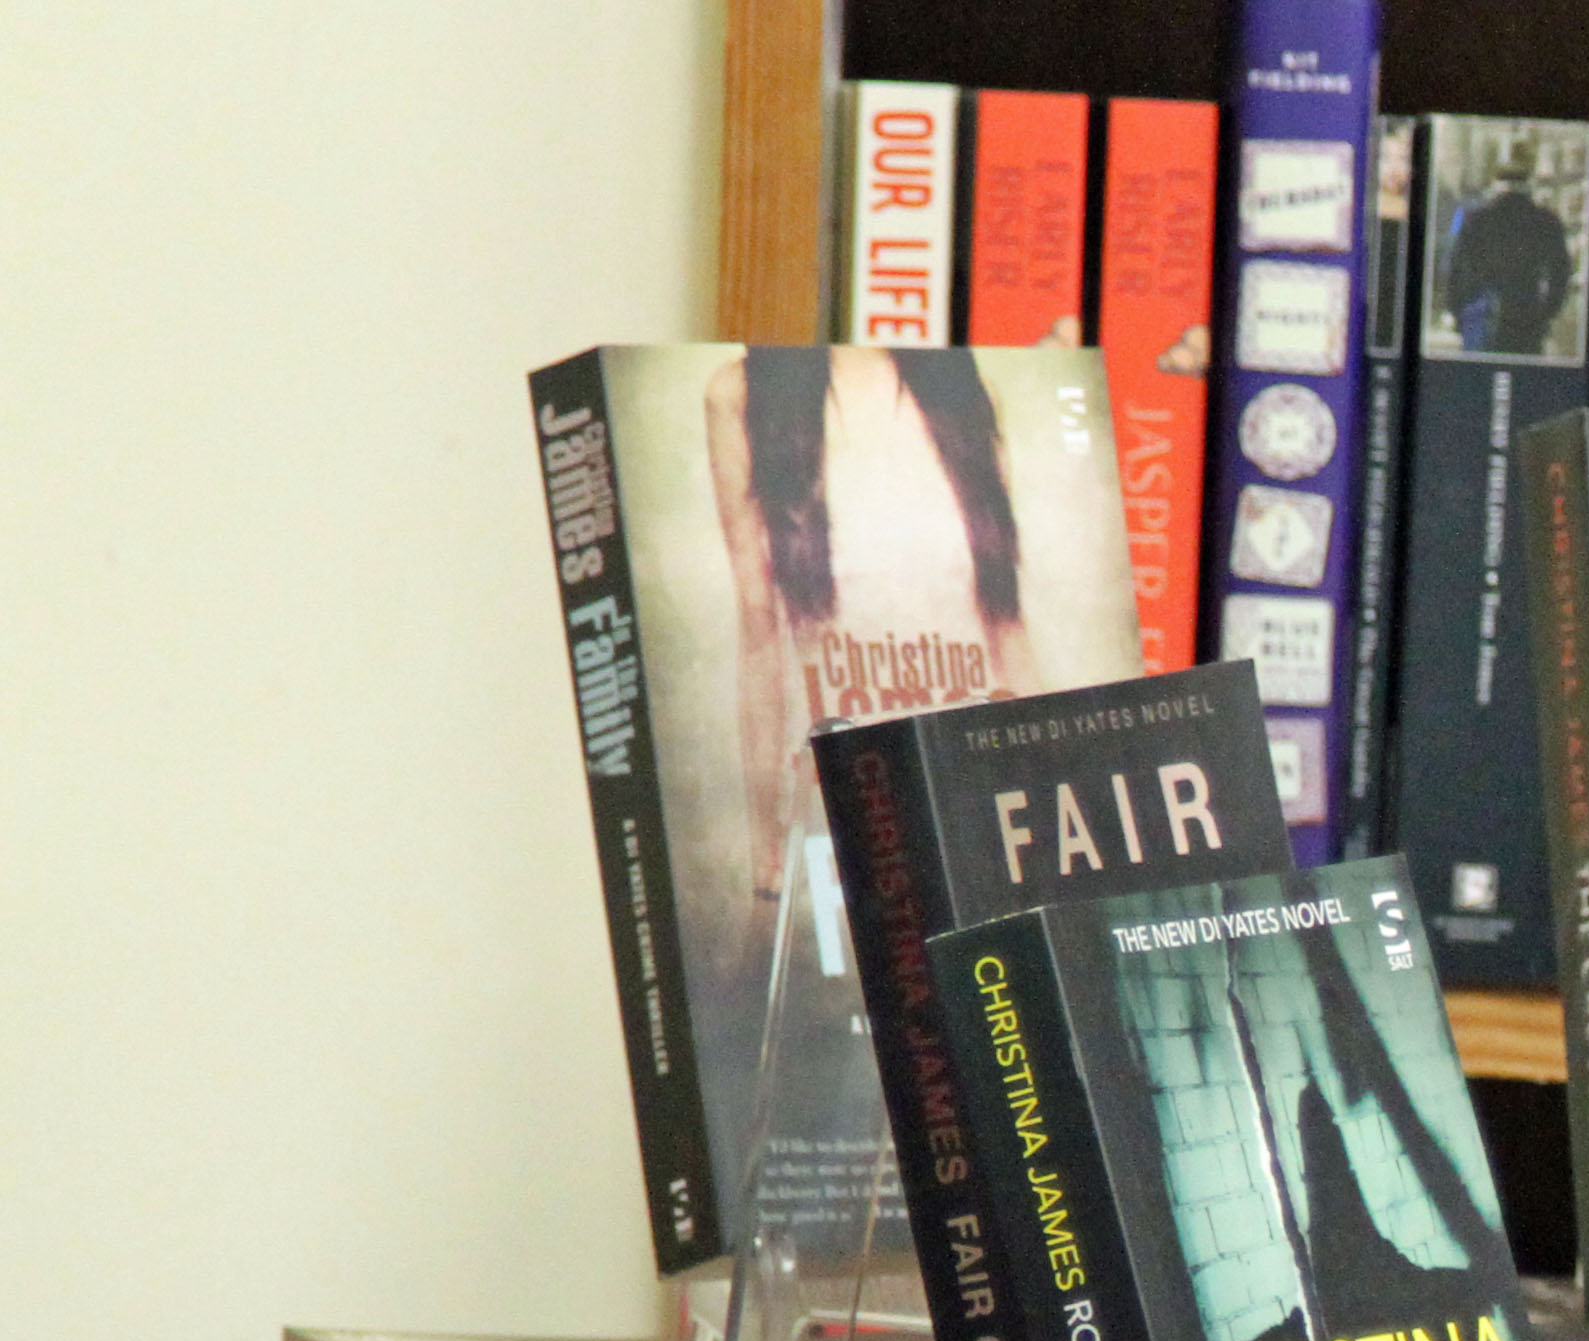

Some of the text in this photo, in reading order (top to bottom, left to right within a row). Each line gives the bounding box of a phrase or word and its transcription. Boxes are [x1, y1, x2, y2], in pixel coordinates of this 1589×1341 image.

[867, 107, 936, 342] OUR LIFE
[540, 402, 604, 586] James
[1123, 404, 1174, 600] JASPER
[568, 594, 636, 777] Family
[819, 628, 988, 691] Christina
[965, 726, 998, 753] THE
[1072, 709, 1135, 738] YATES
[1141, 695, 1216, 730] NOVEL
[993, 760, 1223, 886] FAIR
[1112, 898, 1352, 954] THE NEW DI YATES NOVEL
[973, 954, 1050, 1161] CHRISTINA
[1027, 1164, 1086, 1293] JAMES
[945, 1212, 997, 1320] FAIR
